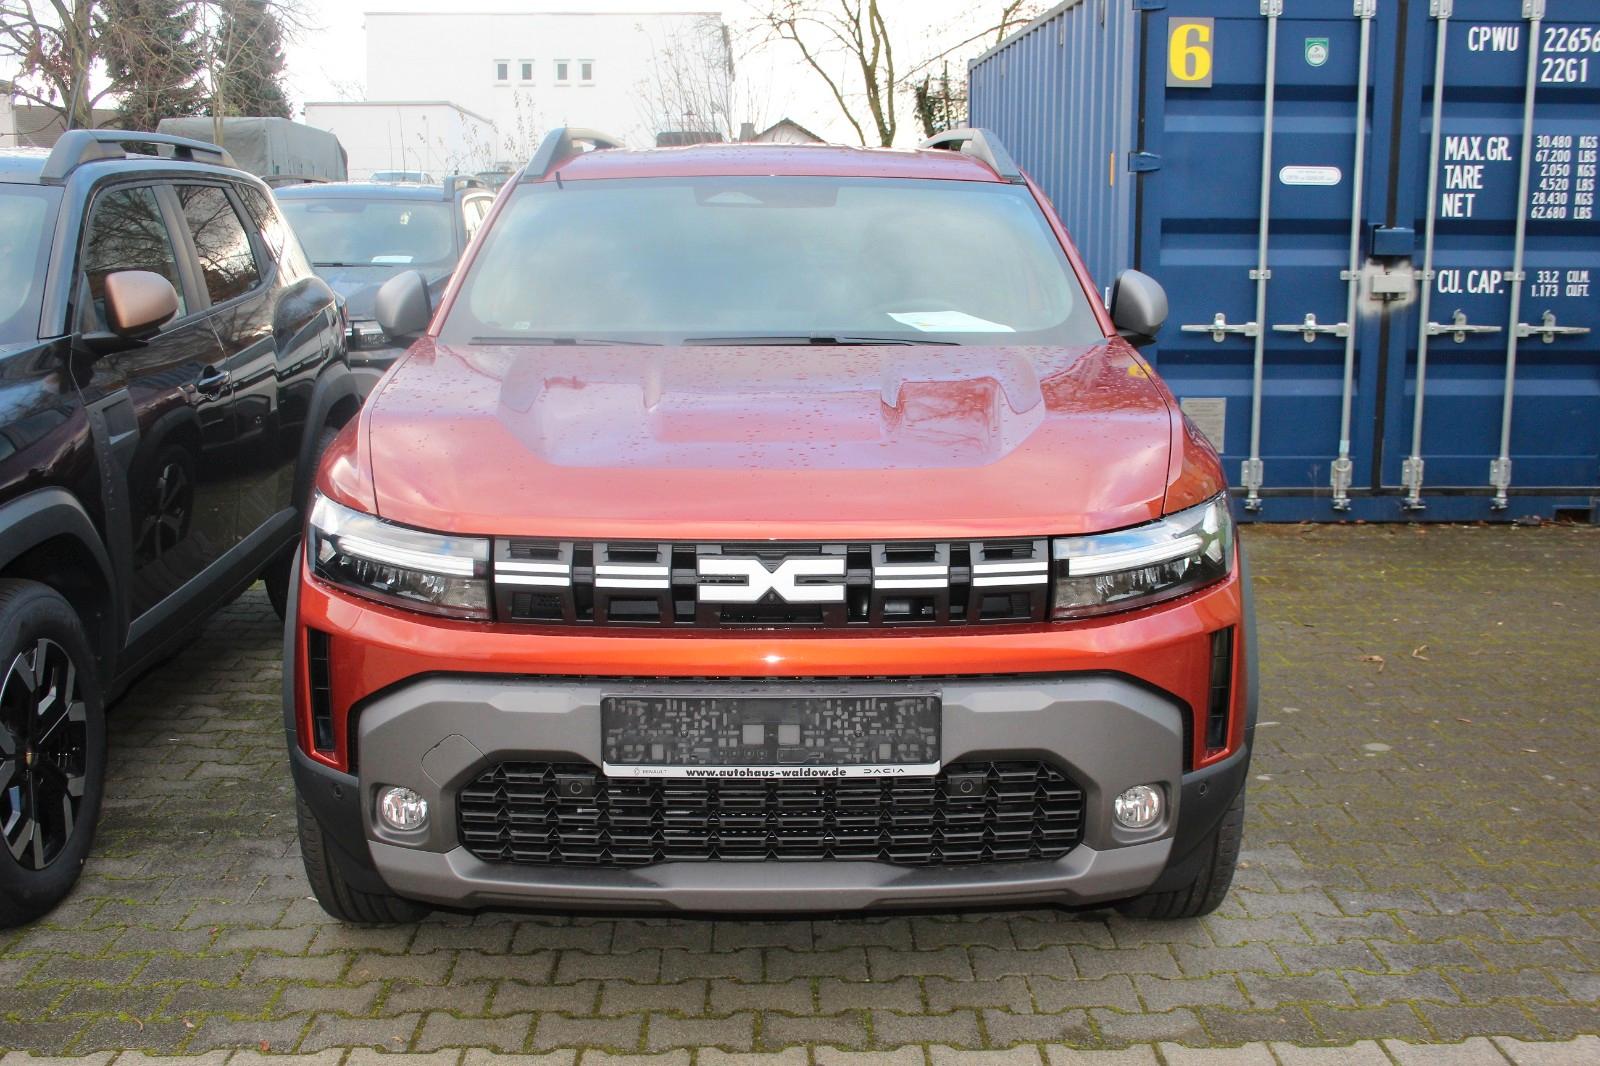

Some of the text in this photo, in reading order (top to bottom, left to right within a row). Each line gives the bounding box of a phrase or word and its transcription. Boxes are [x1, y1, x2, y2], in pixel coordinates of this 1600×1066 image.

[1468, 26, 1600, 52] CPWU 22656
[1169, 24, 1212, 81] 6
[1541, 57, 1589, 83] 22G1
[1535, 135, 1599, 149] 30.480 KGS
[1535, 149, 1598, 163] 67.200 LBS
[1444, 165, 1485, 189] TARE
[1540, 164, 1597, 177] 2.050 KGS
[1539, 178, 1595, 191] 4.520 LBS
[1441, 193, 1476, 217] NET
[1531, 192, 1594, 205] 28.430 KGS
[1530, 206, 1593, 219] 62.680 LBS
[1437, 269, 1504, 294] CU. CAP.
[1537, 270, 1560, 283] 33.2
[1531, 284, 1559, 297] 1.173
[686, 767, 847, 777] www.autohaus-waldow.de
